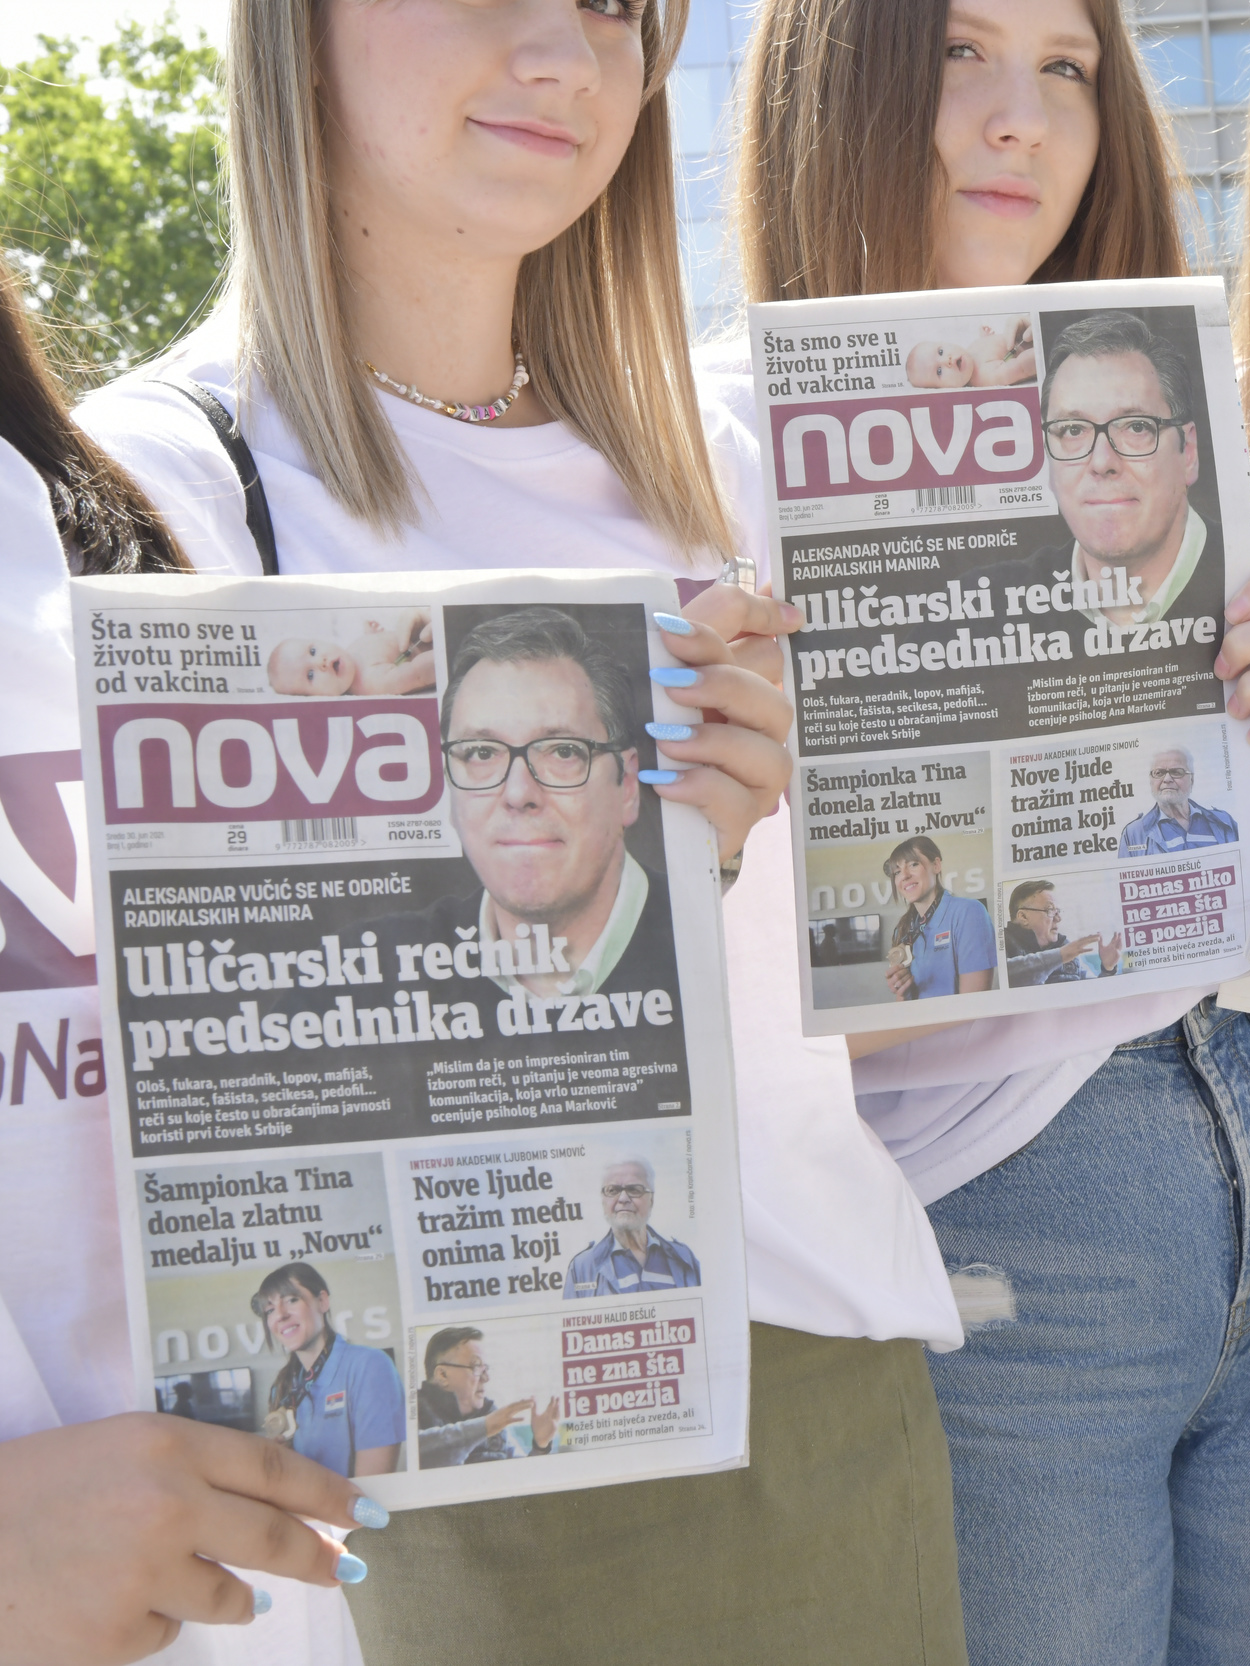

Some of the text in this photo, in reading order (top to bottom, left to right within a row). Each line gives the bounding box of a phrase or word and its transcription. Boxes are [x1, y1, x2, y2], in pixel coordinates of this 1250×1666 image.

[763, 330, 897, 353] Šta smo sve u
[765, 347, 901, 375] životu primili
[767, 372, 875, 396] od vakcina
[782, 400, 1034, 488] nova
[874, 499, 889, 510] 29
[999, 492, 1043, 504] nova.rs
[791, 528, 1017, 563] ALEKSANDAR VUČIĆ SE NE ODRIČE
[792, 555, 940, 580] RADIKALSKIH MANIRA
[791, 566, 1144, 633] Uličarski rečnik
[91, 612, 256, 640] Šta smo sve u
[93, 643, 261, 670] životu primili
[798, 611, 1217, 691] predsednika države
[95, 669, 229, 694] od vakcina
[1027, 690, 1064, 701] izborom
[1098, 681, 1129, 695] pitanju
[1131, 679, 1140, 691] je
[1142, 677, 1170, 687] veoma
[1171, 671, 1213, 685] agresivna
[1065, 675, 1076, 685] da
[1078, 674, 1087, 686] je
[1088, 674, 1100, 682] on
[1102, 665, 1163, 681] impresioniran
[1164, 662, 1178, 672] tim
[1028, 699, 1166, 726] ocenjuje psiholog Ana Marković
[1092, 695, 1111, 707] koja
[1113, 693, 1130, 703] vrlo
[804, 707, 998, 733] reči su koje često u obraćanjima javnosti
[804, 727, 920, 746] koristi prvi čovek Srbije
[1009, 737, 1139, 764] INTERVJU AKADEMIK LJUBOMIR SIMOVIĆ
[113, 713, 432, 809] nova
[227, 831, 247, 845] 29
[388, 829, 442, 842] nova.rs
[122, 871, 411, 905] ALEKSANDAR VUČIĆ SE NE ODRIČE
[124, 903, 313, 927] RADIKALSKIH MANIRA
[123, 923, 571, 998] Uličarski rečnik
[129, 981, 673, 1072] predsednika države
[143, 1166, 353, 1205] Šampionka Tina
[412, 1165, 552, 1200] Nove ljude
[147, 1202, 322, 1235] donela zlatnu
[417, 1196, 583, 1234] tražim među
[150, 1224, 382, 1267] medalju u „Novu“
[422, 1230, 561, 1267] onima koji
[423, 1265, 562, 1301] brane reke
[565, 1321, 691, 1354] Danas niko
[566, 1351, 680, 1385] ne zna šta
[567, 1382, 676, 1418] je poezija
